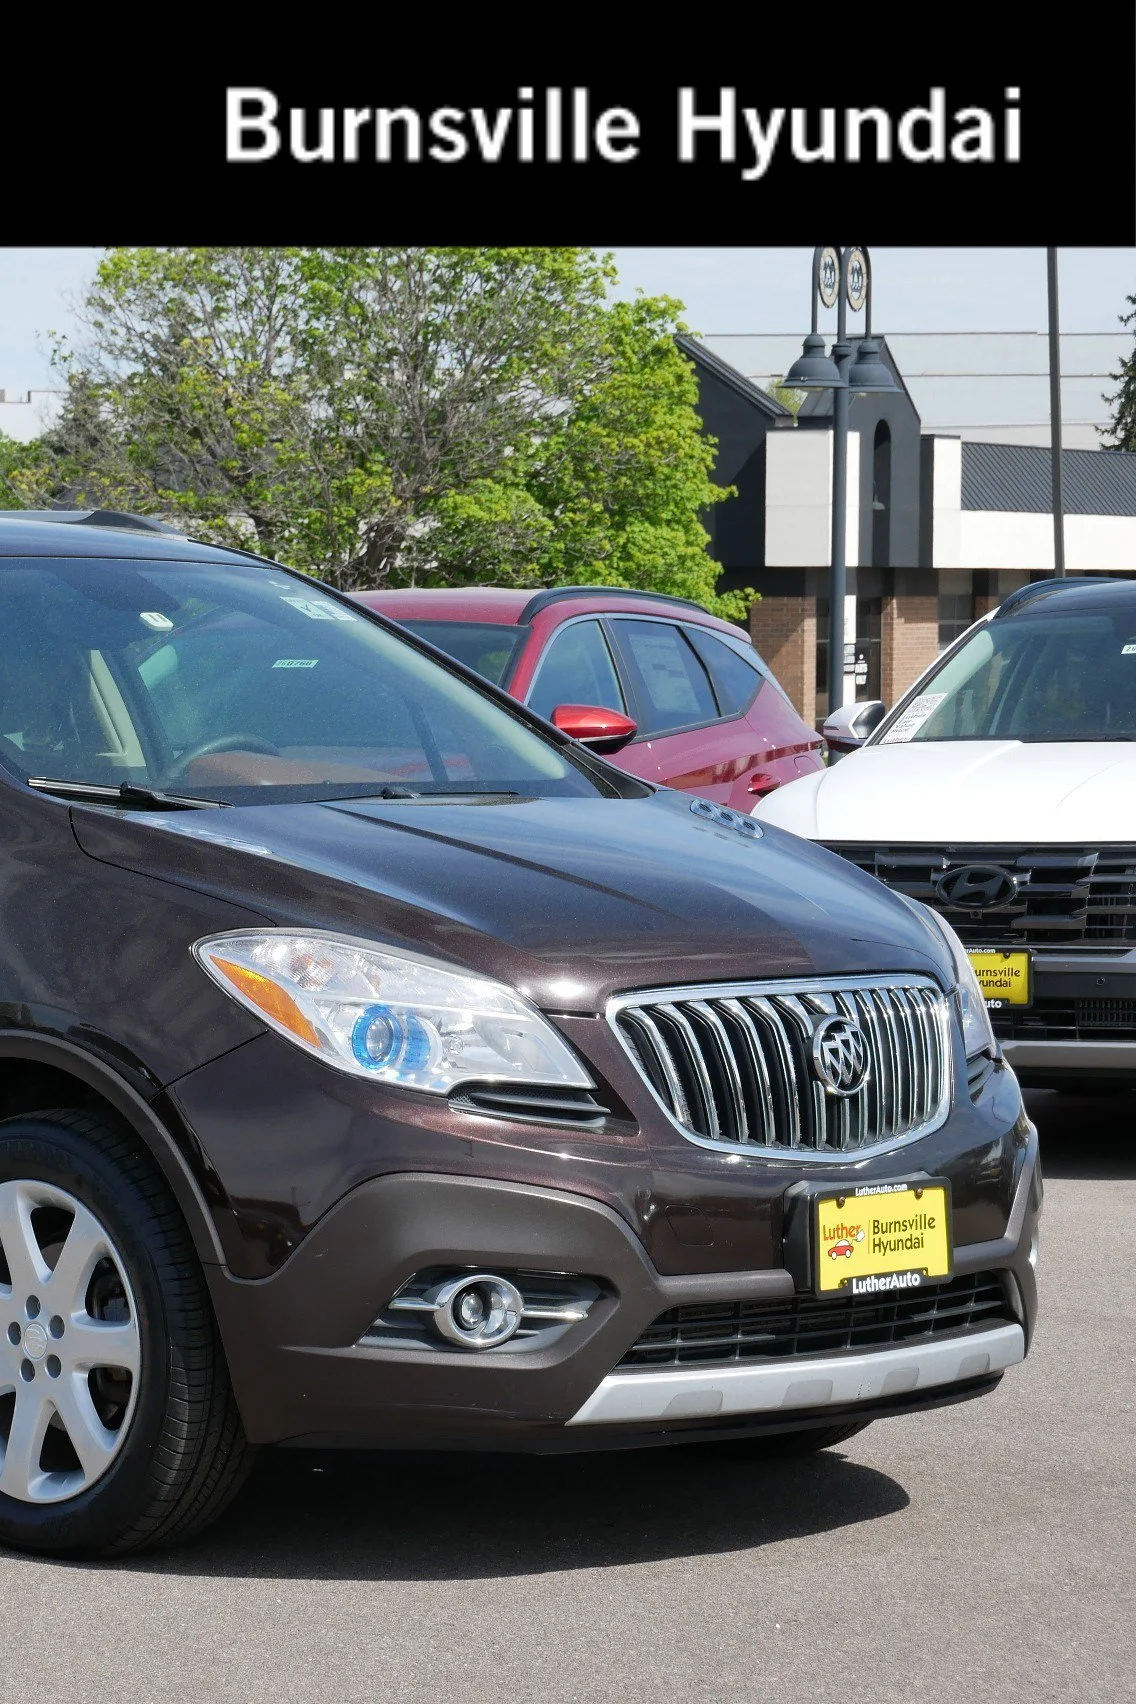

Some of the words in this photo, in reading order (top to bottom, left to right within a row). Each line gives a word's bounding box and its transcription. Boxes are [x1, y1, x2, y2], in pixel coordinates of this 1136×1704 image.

[974, 967, 1021, 977] urnsville
[978, 977, 1012, 988] undai
[855, 1183, 908, 1197] LutherAuto.com
[822, 1222, 862, 1241] Luther
[872, 1213, 936, 1235] Burnsville
[872, 1233, 925, 1256] Hyundai
[852, 1272, 921, 1294] LutherAuto
